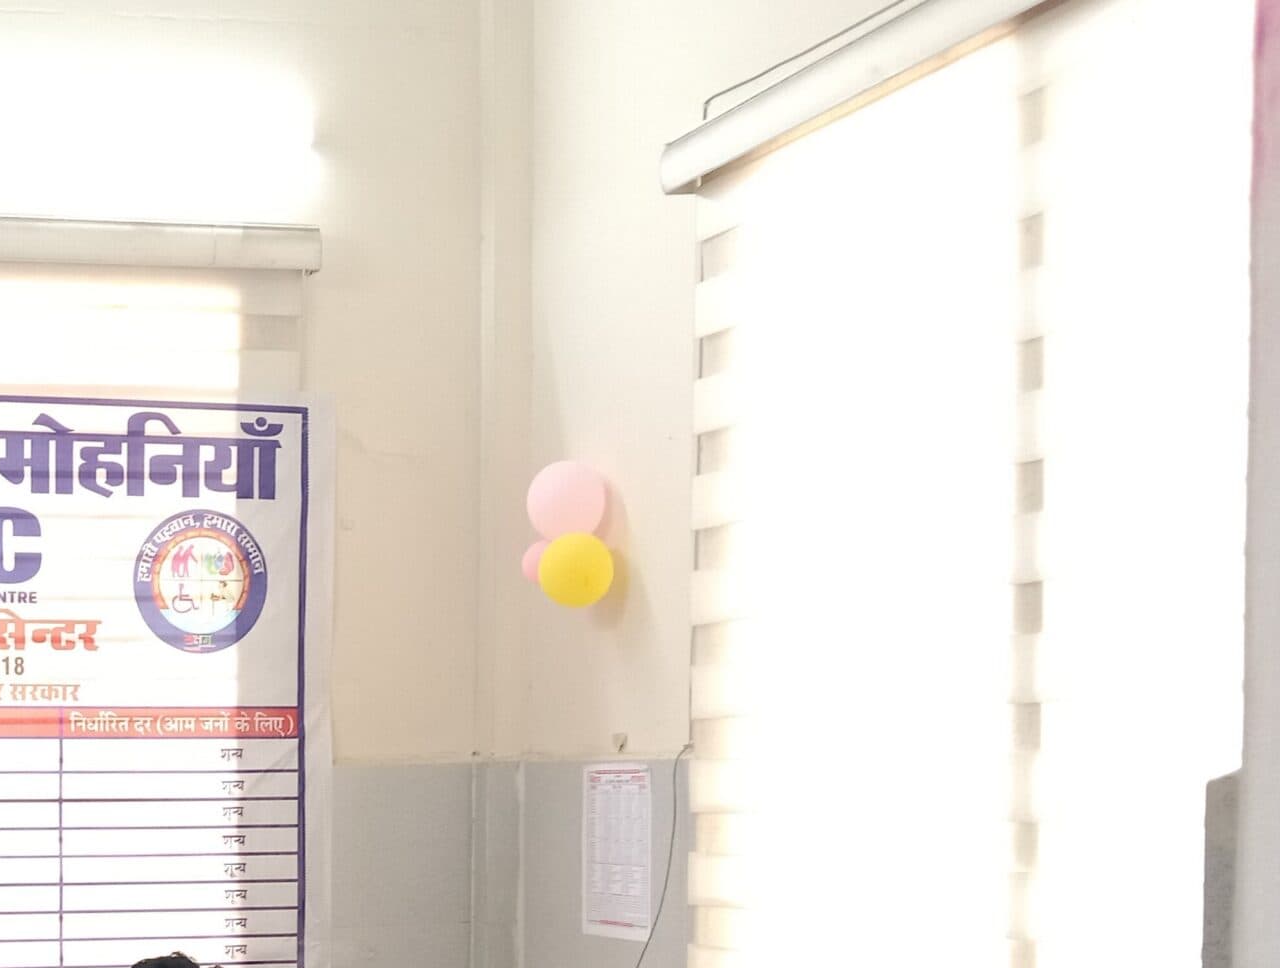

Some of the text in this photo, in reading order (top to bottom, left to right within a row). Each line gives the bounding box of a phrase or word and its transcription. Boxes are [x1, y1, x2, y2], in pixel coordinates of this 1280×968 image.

[9, 682, 81, 702] सरकार
[70, 711, 130, 733] निर्धारित
[133, 715, 153, 733] दर
[233, 712, 251, 733] के
